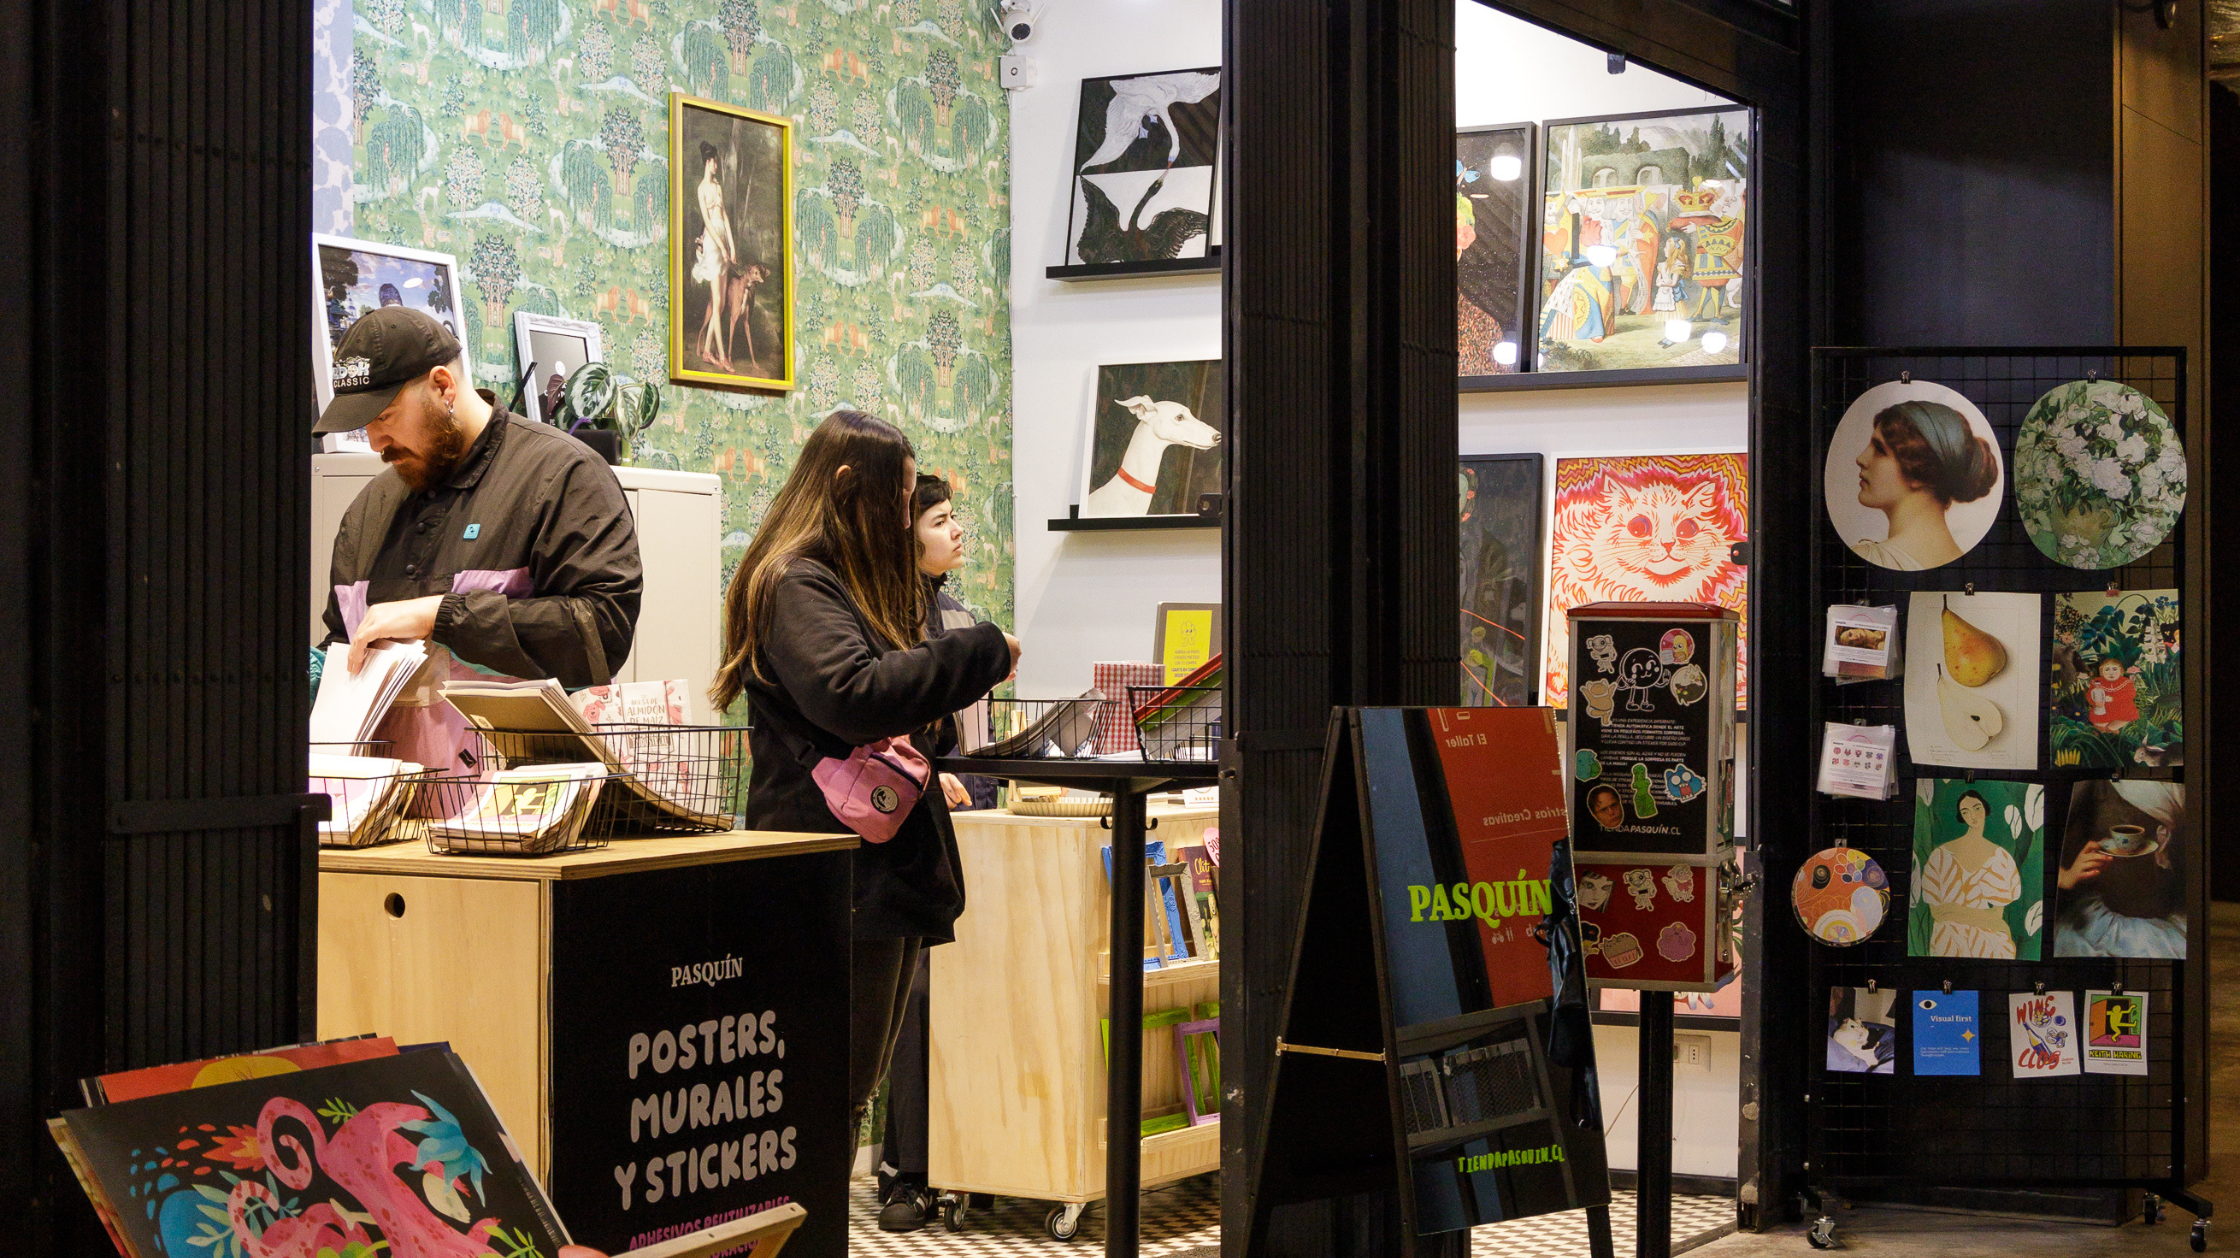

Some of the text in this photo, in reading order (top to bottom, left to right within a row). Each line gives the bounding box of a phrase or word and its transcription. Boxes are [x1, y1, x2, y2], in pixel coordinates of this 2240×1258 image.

[334, 377, 369, 388] CLASSIC
[1408, 869, 1553, 929] PASQUÍN
[671, 953, 743, 988] PASQUÍN
[628, 1010, 785, 1079] POSTERS,
[2089, 1050, 2142, 1059] KEITH HARING
[630, 1069, 784, 1143] MURALES
[614, 1127, 797, 1210] Y STICKERS
